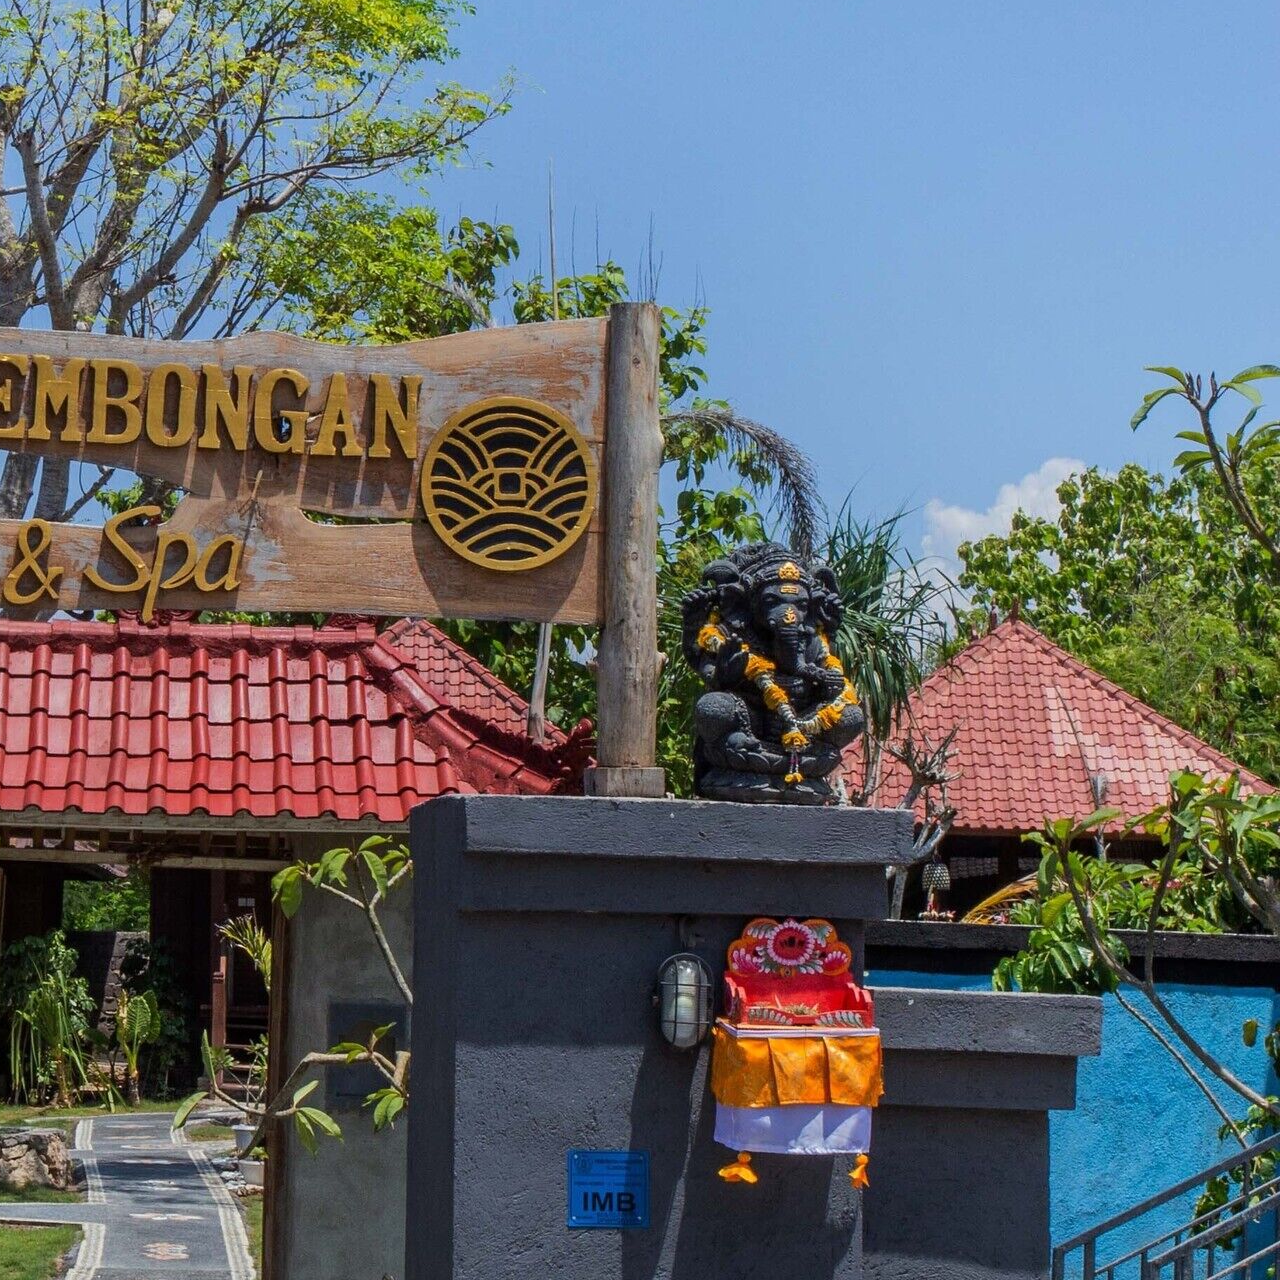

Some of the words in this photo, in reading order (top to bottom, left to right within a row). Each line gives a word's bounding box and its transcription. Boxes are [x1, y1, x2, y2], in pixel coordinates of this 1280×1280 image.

[3, 518, 64, 604] &
[83, 506, 242, 622] Spa
[582, 1191, 637, 1213] IMB
